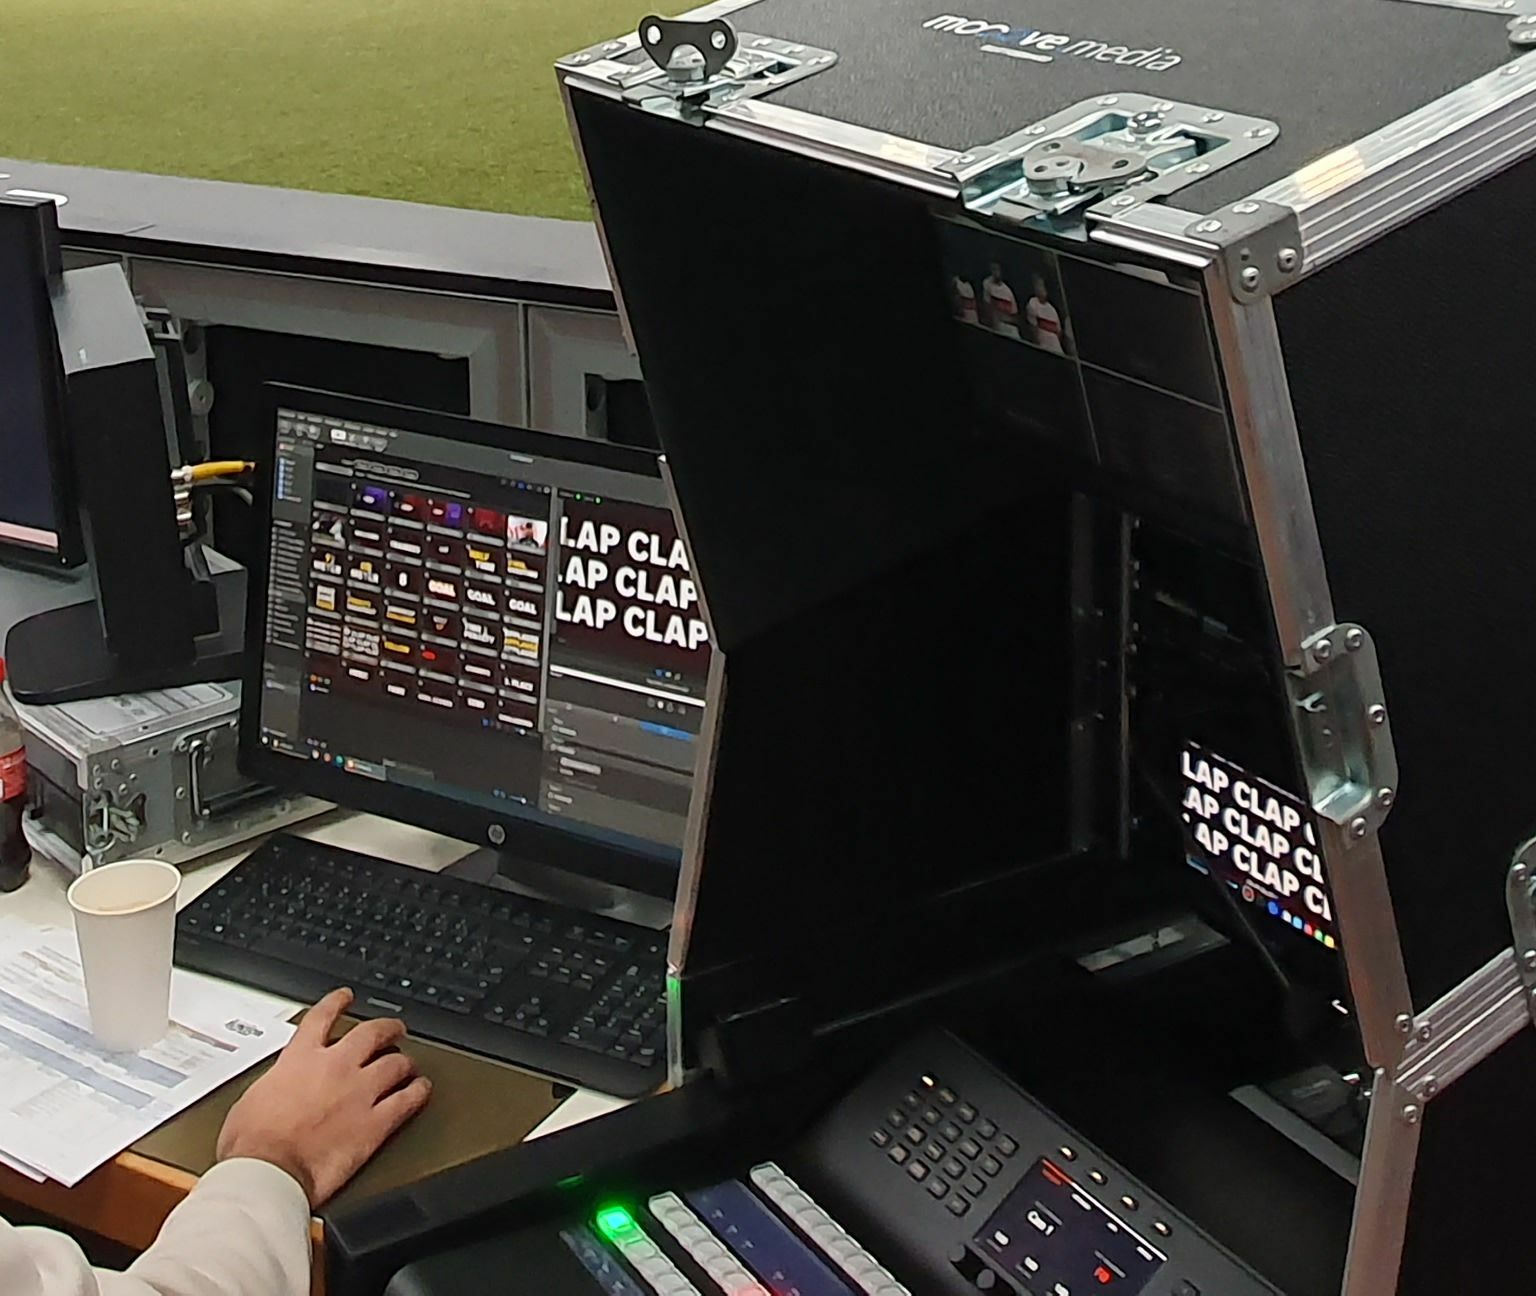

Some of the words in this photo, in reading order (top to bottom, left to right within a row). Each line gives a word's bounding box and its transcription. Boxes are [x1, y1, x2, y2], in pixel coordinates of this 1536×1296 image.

[1061, 40, 1182, 71] media
[467, 589, 496, 606] GOAL
[509, 598, 537, 615] GOAL
[558, 556, 608, 590] AP
[615, 565, 699, 610] CLAP
[555, 590, 617, 629] LAP
[623, 605, 710, 650] CLAP
[1181, 751, 1229, 793] LAP
[1233, 781, 1300, 832] CLAP
[1223, 807, 1290, 859] CLAP
[1233, 844, 1300, 896] CLAP
